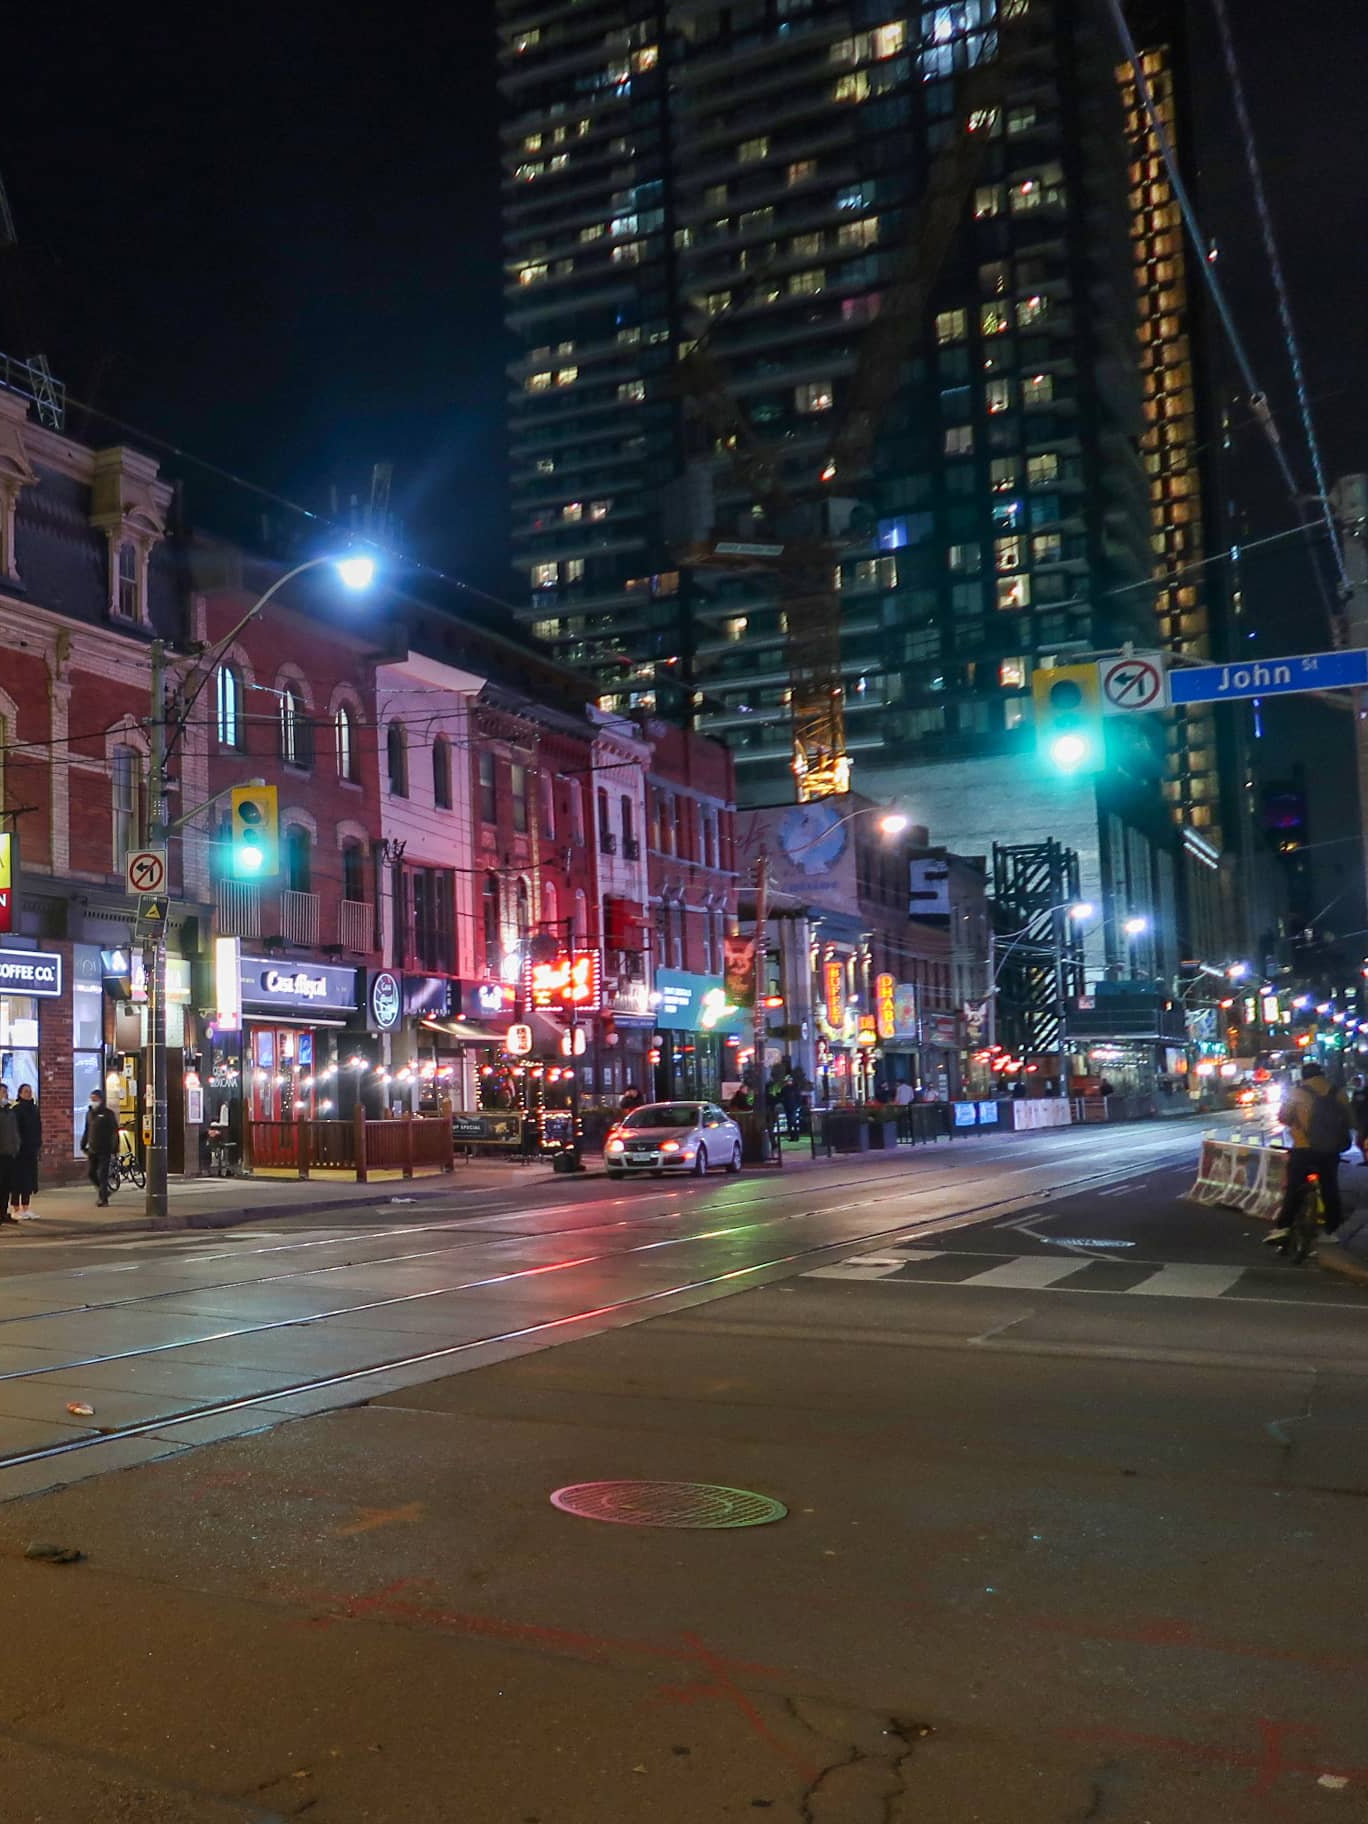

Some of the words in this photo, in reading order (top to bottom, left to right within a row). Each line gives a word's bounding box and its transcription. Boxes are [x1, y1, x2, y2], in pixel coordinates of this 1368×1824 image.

[1217, 663, 1291, 691] John
[1301, 657, 1319, 671] St
[830, 967, 841, 1025] BUFFET
[881, 976, 894, 1036] DHABA
